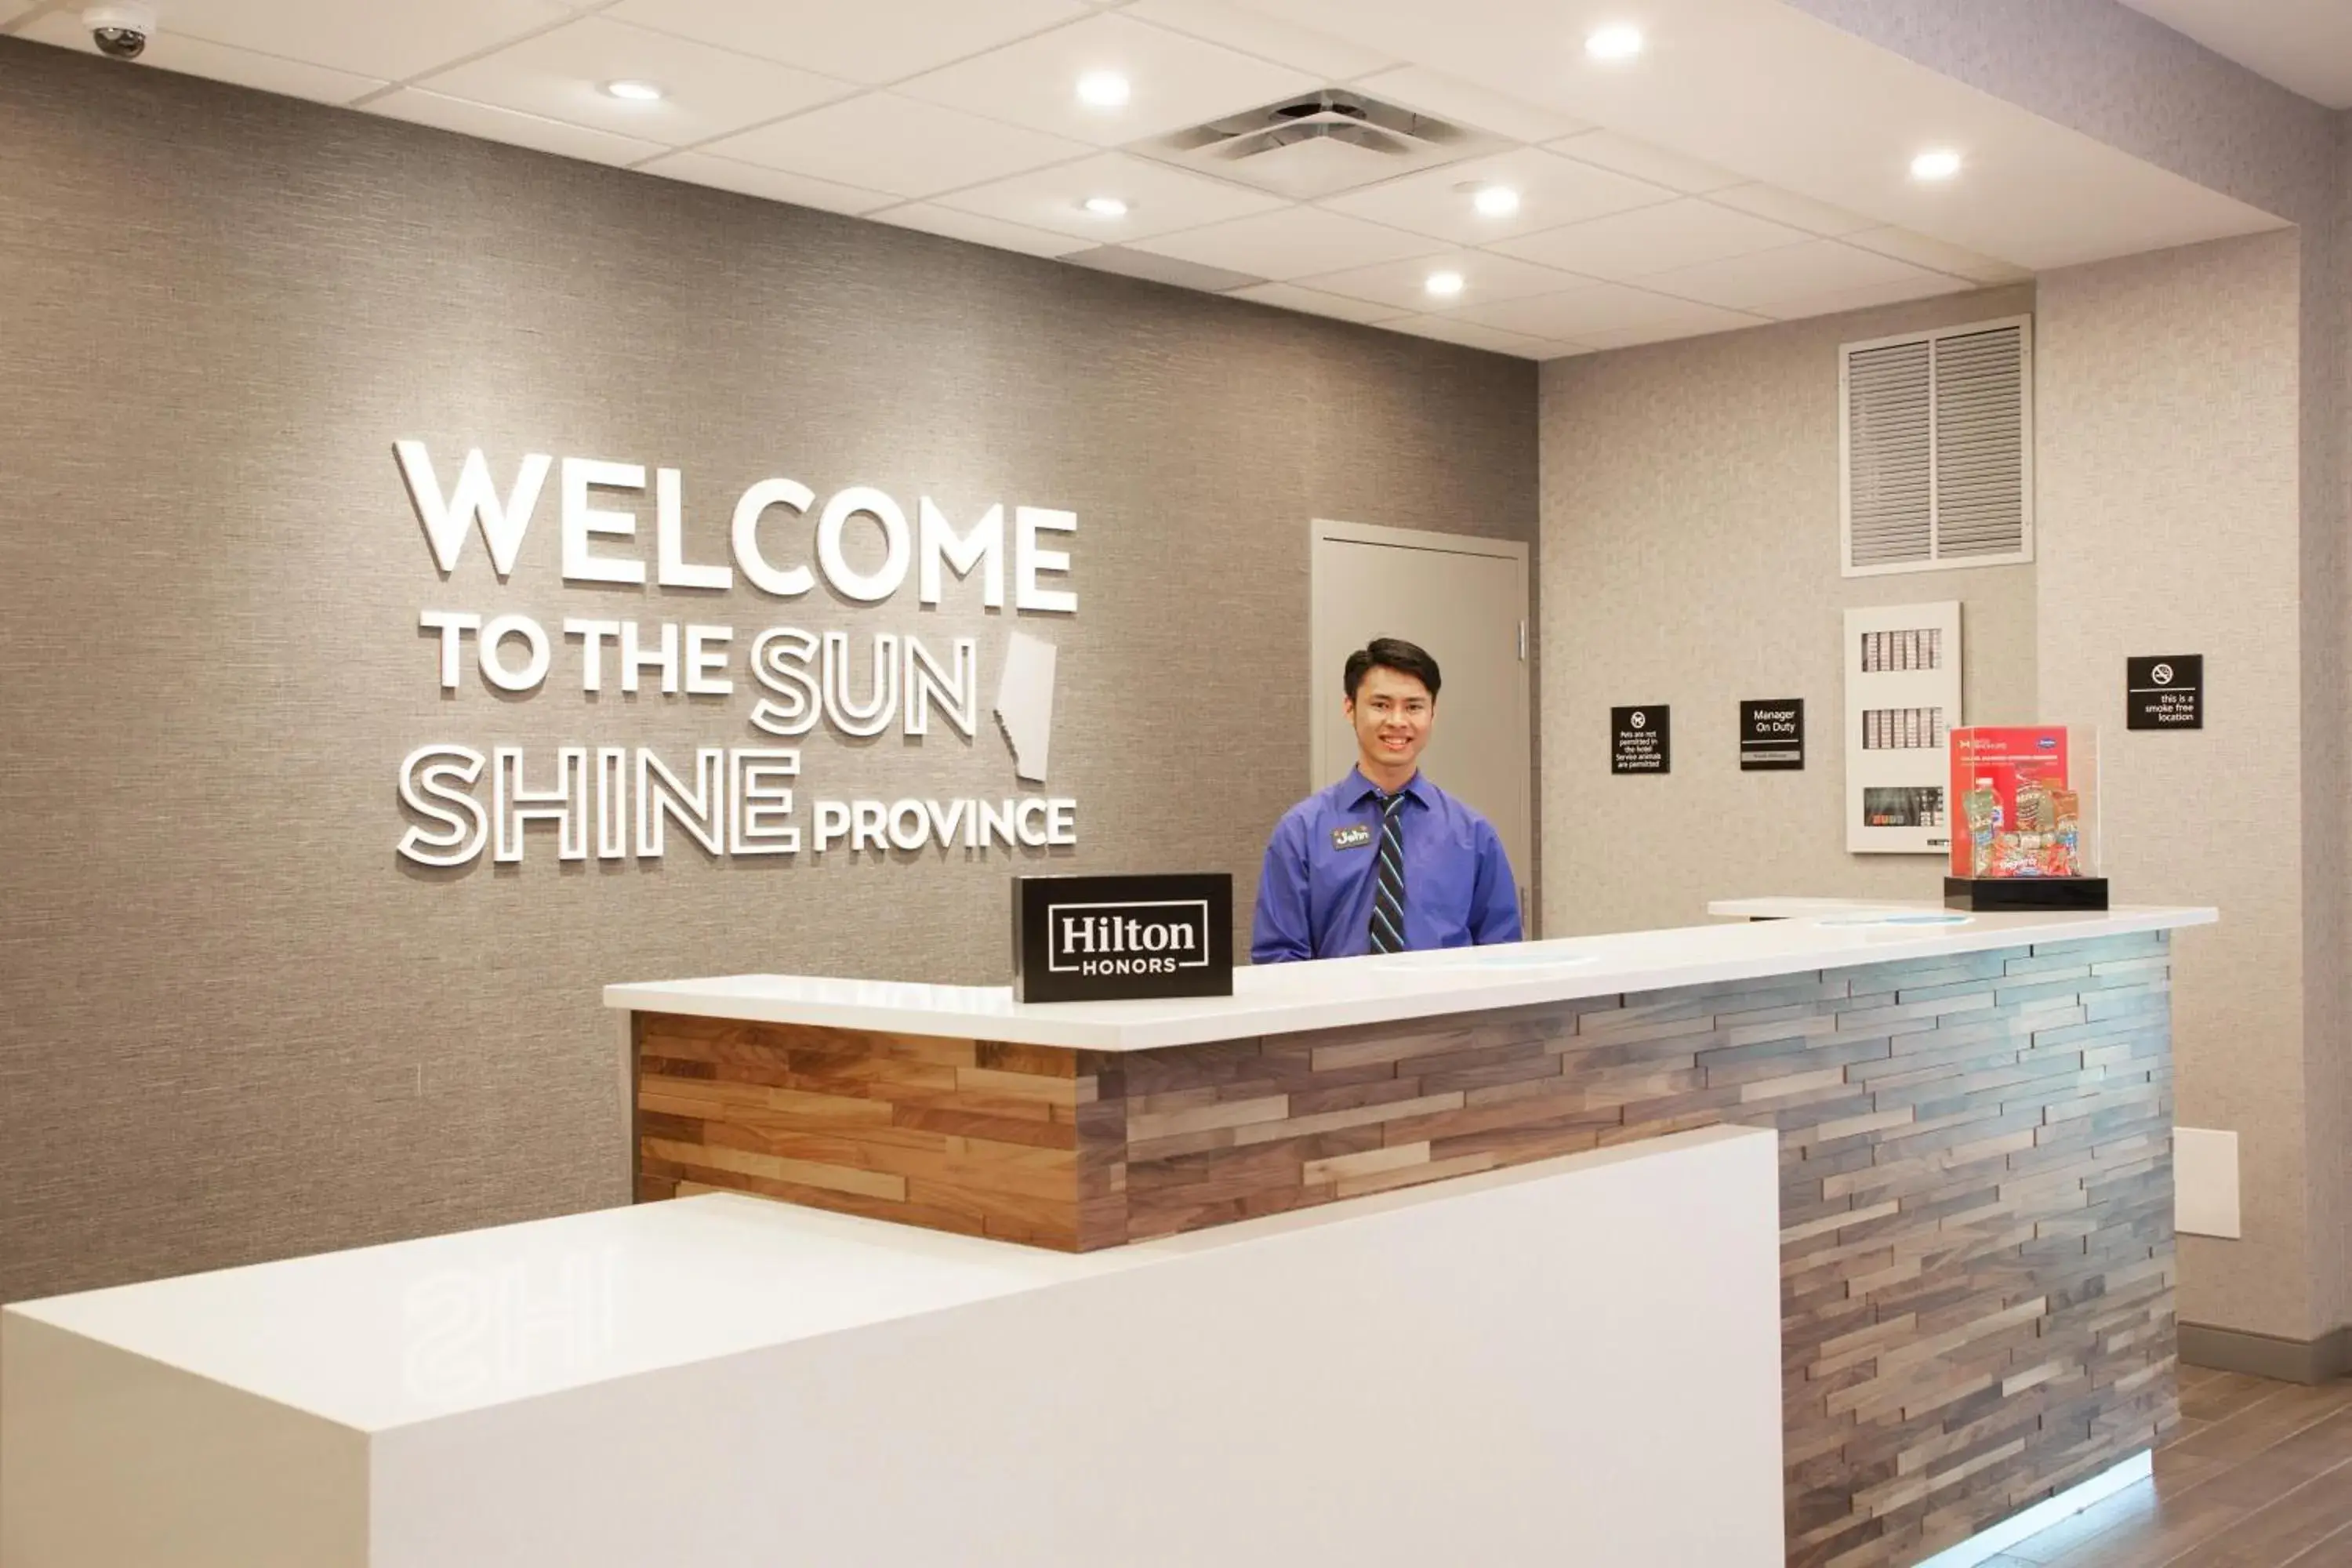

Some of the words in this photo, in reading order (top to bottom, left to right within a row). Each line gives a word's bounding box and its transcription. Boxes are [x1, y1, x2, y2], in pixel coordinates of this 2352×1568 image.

[393, 440, 1078, 613] WELCOME
[419, 611, 551, 692] TO
[563, 619, 735, 695] THE
[749, 628, 977, 737] SUN
[2161, 695, 2176, 703] this
[1754, 710, 1795, 721] Manager
[2145, 704, 2173, 713] smoke
[2176, 703, 2194, 712] free
[2158, 713, 2194, 722] location
[1756, 722, 1771, 732] On
[1773, 721, 1795, 734] Duty
[397, 744, 801, 868] SHINE
[812, 797, 1077, 853] PROVINCE
[1062, 916, 1195, 953] Hilton
[1083, 957, 1177, 976] HONORS
